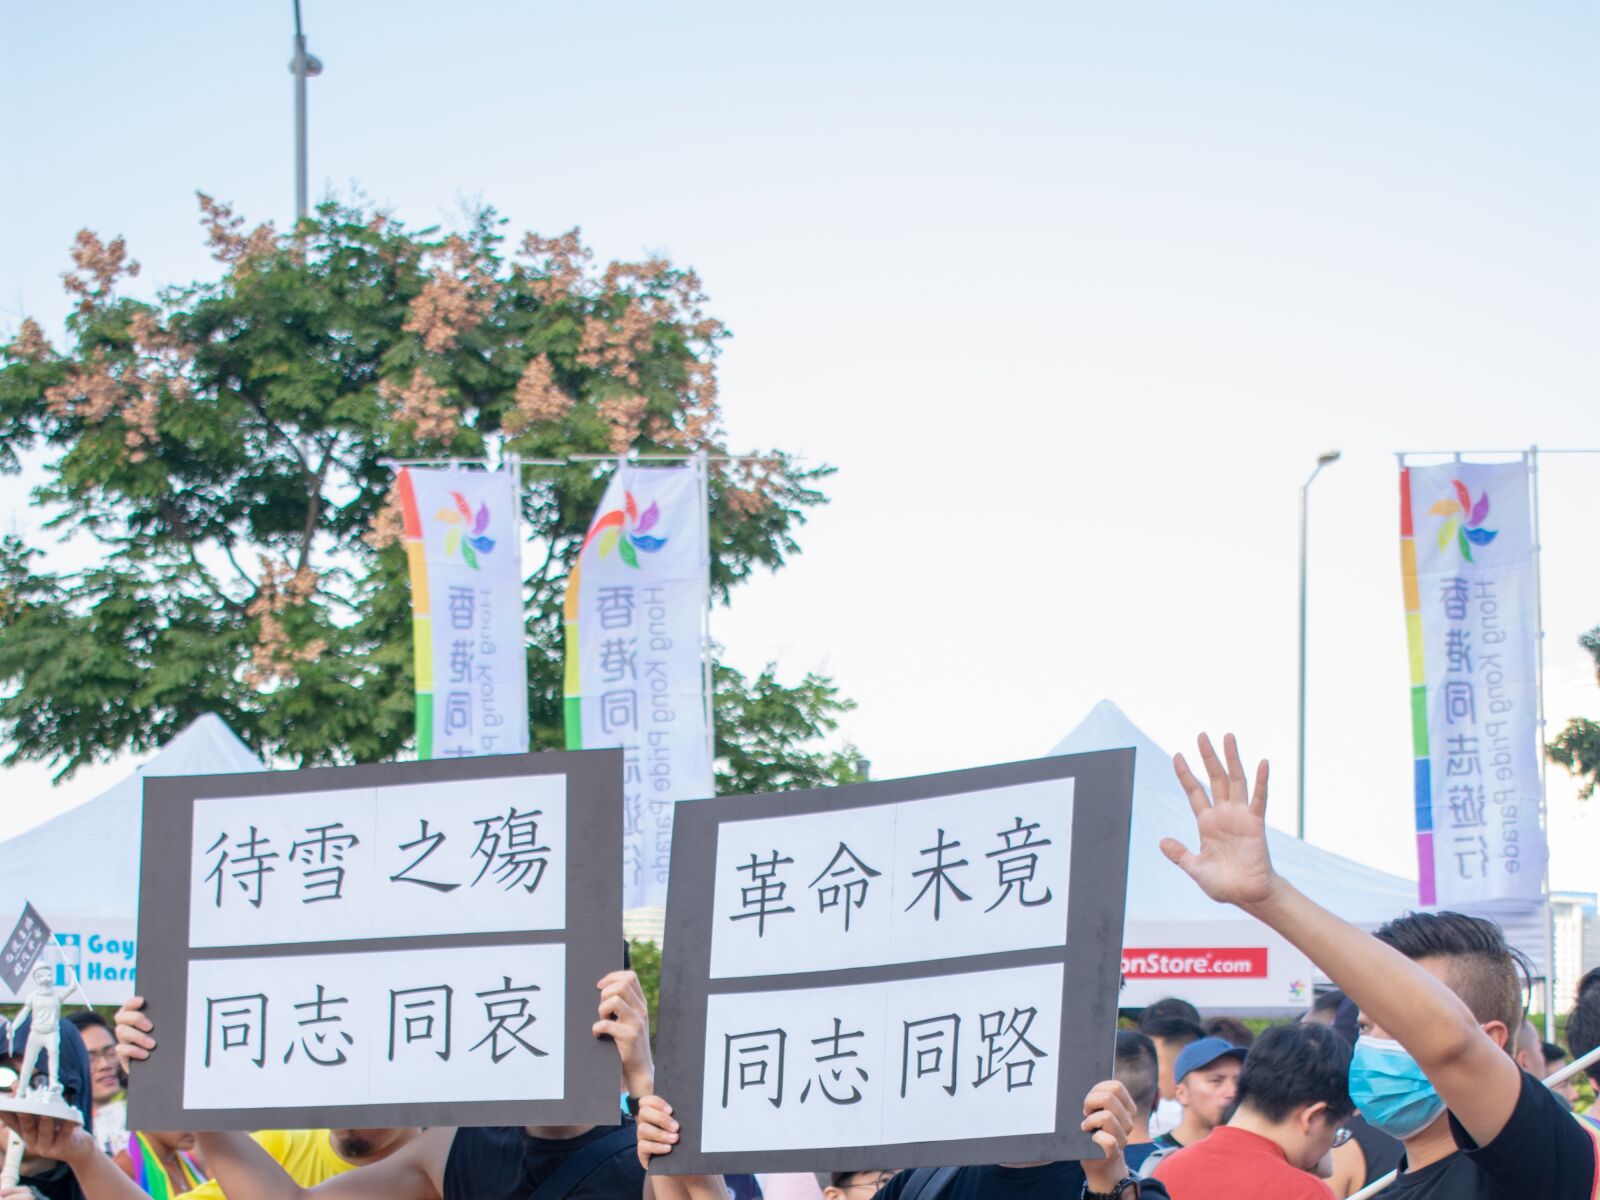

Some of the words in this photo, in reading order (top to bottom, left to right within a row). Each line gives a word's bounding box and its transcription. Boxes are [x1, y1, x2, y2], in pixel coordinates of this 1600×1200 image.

[728, 815, 1053, 938] 革命未竟
[88, 934, 134, 960] Gay
[204, 975, 549, 1069] 同志同哀
[721, 1005, 1049, 1109] 同志同路
